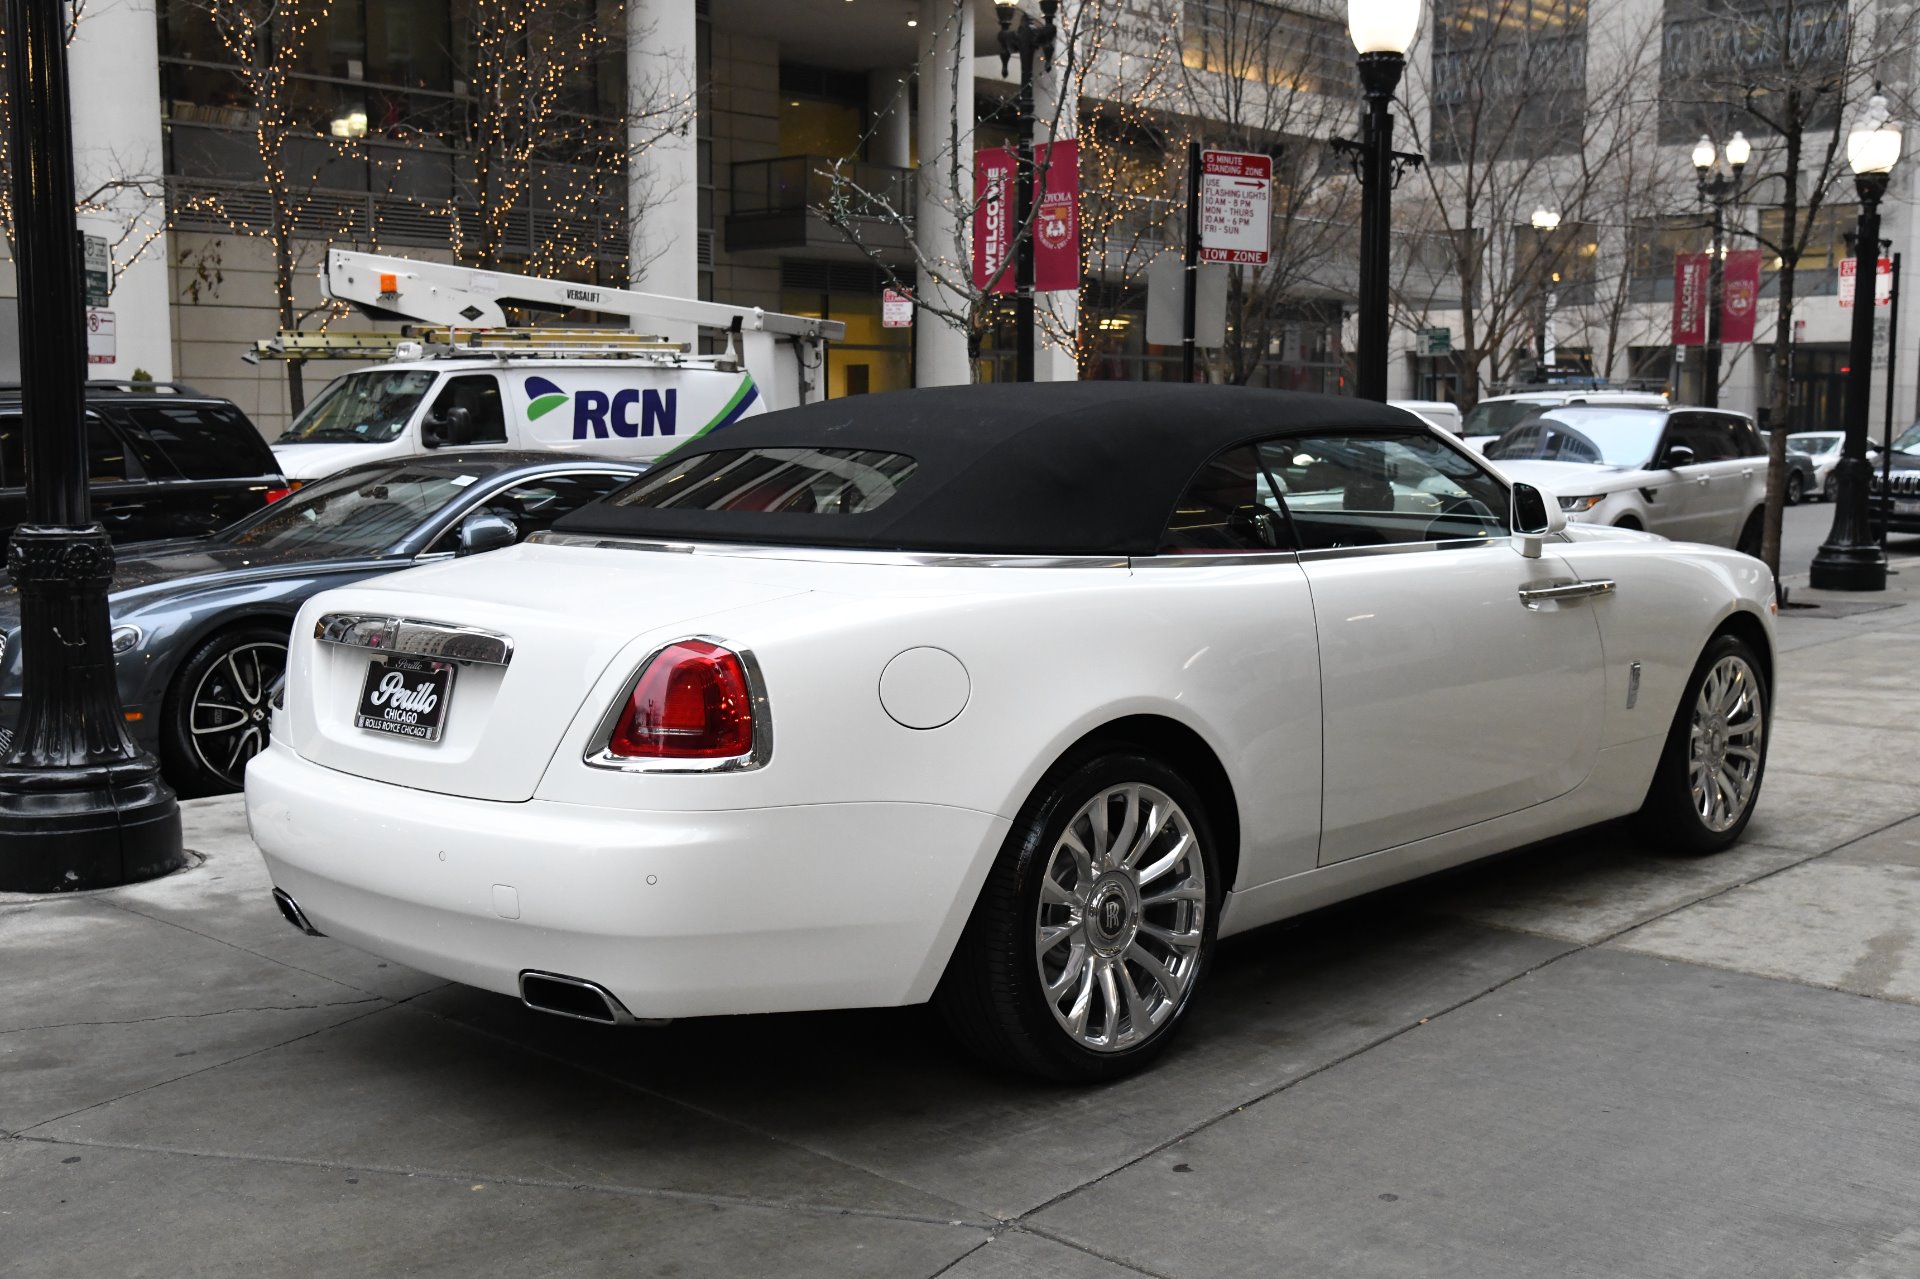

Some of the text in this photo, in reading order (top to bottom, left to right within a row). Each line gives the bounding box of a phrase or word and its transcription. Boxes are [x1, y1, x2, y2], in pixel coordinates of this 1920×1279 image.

[1206, 154, 1243, 166] 15 MINUTE
[1206, 165, 1264, 176] STANDING ZONE
[1206, 179, 1220, 187] USE
[1044, 191, 1072, 203] OYOLA
[1205, 188, 1267, 200] FLASHING LIGHTS
[1205, 197, 1214, 205] 10
[1215, 198, 1226, 206] AM
[1233, 199, 1238, 207] 8
[1240, 200, 1251, 208] PM
[1205, 206, 1222, 214] MON
[1230, 208, 1254, 217] THURS
[1205, 215, 1214, 223] 10
[1215, 216, 1225, 224] AM
[1239, 218, 1250, 226] PM
[1204, 224, 1217, 233] FRI
[1223, 225, 1239, 234] SUN
[1205, 249, 1262, 263] TOW ZONE
[567, 289, 600, 303] VERSALIFT
[573, 388, 677, 440] RCN
[395, 659, 422, 670] Perillo
[371, 671, 437, 714] Perillo
[384, 708, 417, 724] CHICAGO
[365, 718, 425, 737] ROLLS ROYCE CHICAGO
